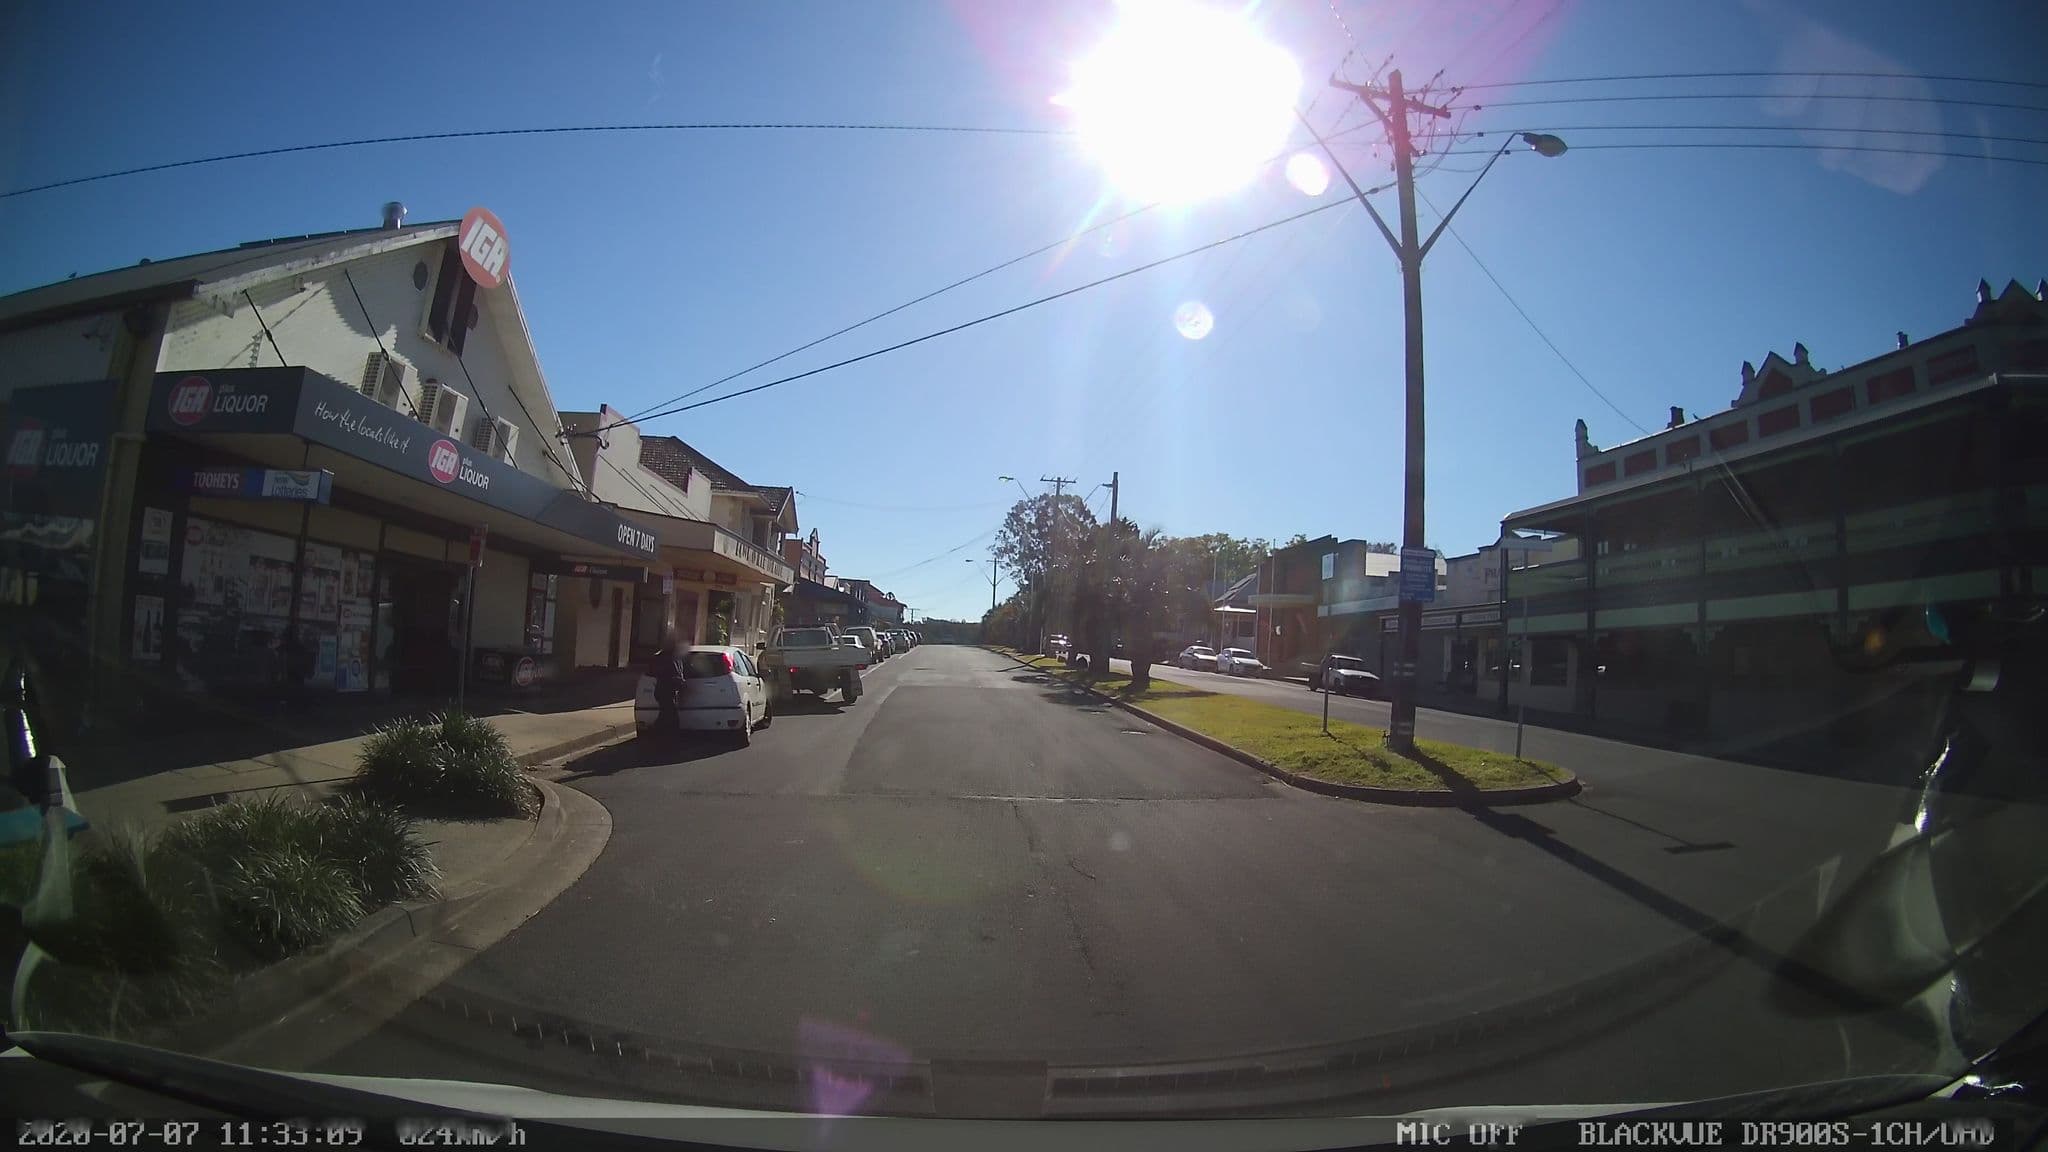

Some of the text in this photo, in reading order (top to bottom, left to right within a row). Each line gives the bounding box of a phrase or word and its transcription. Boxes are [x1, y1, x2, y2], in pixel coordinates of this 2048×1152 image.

[461, 215, 508, 279] IGA
[173, 385, 210, 413] IGA
[213, 394, 269, 414] LIQUOR
[314, 401, 340, 421] How
[340, 409, 356, 432] the
[47, 441, 99, 467] LIQUOR
[431, 446, 459, 475] IGA
[193, 471, 240, 489] TOOHEYS
[459, 465, 489, 490] LIQUOR
[618, 524, 656, 553] OPEN 7 DAYS
